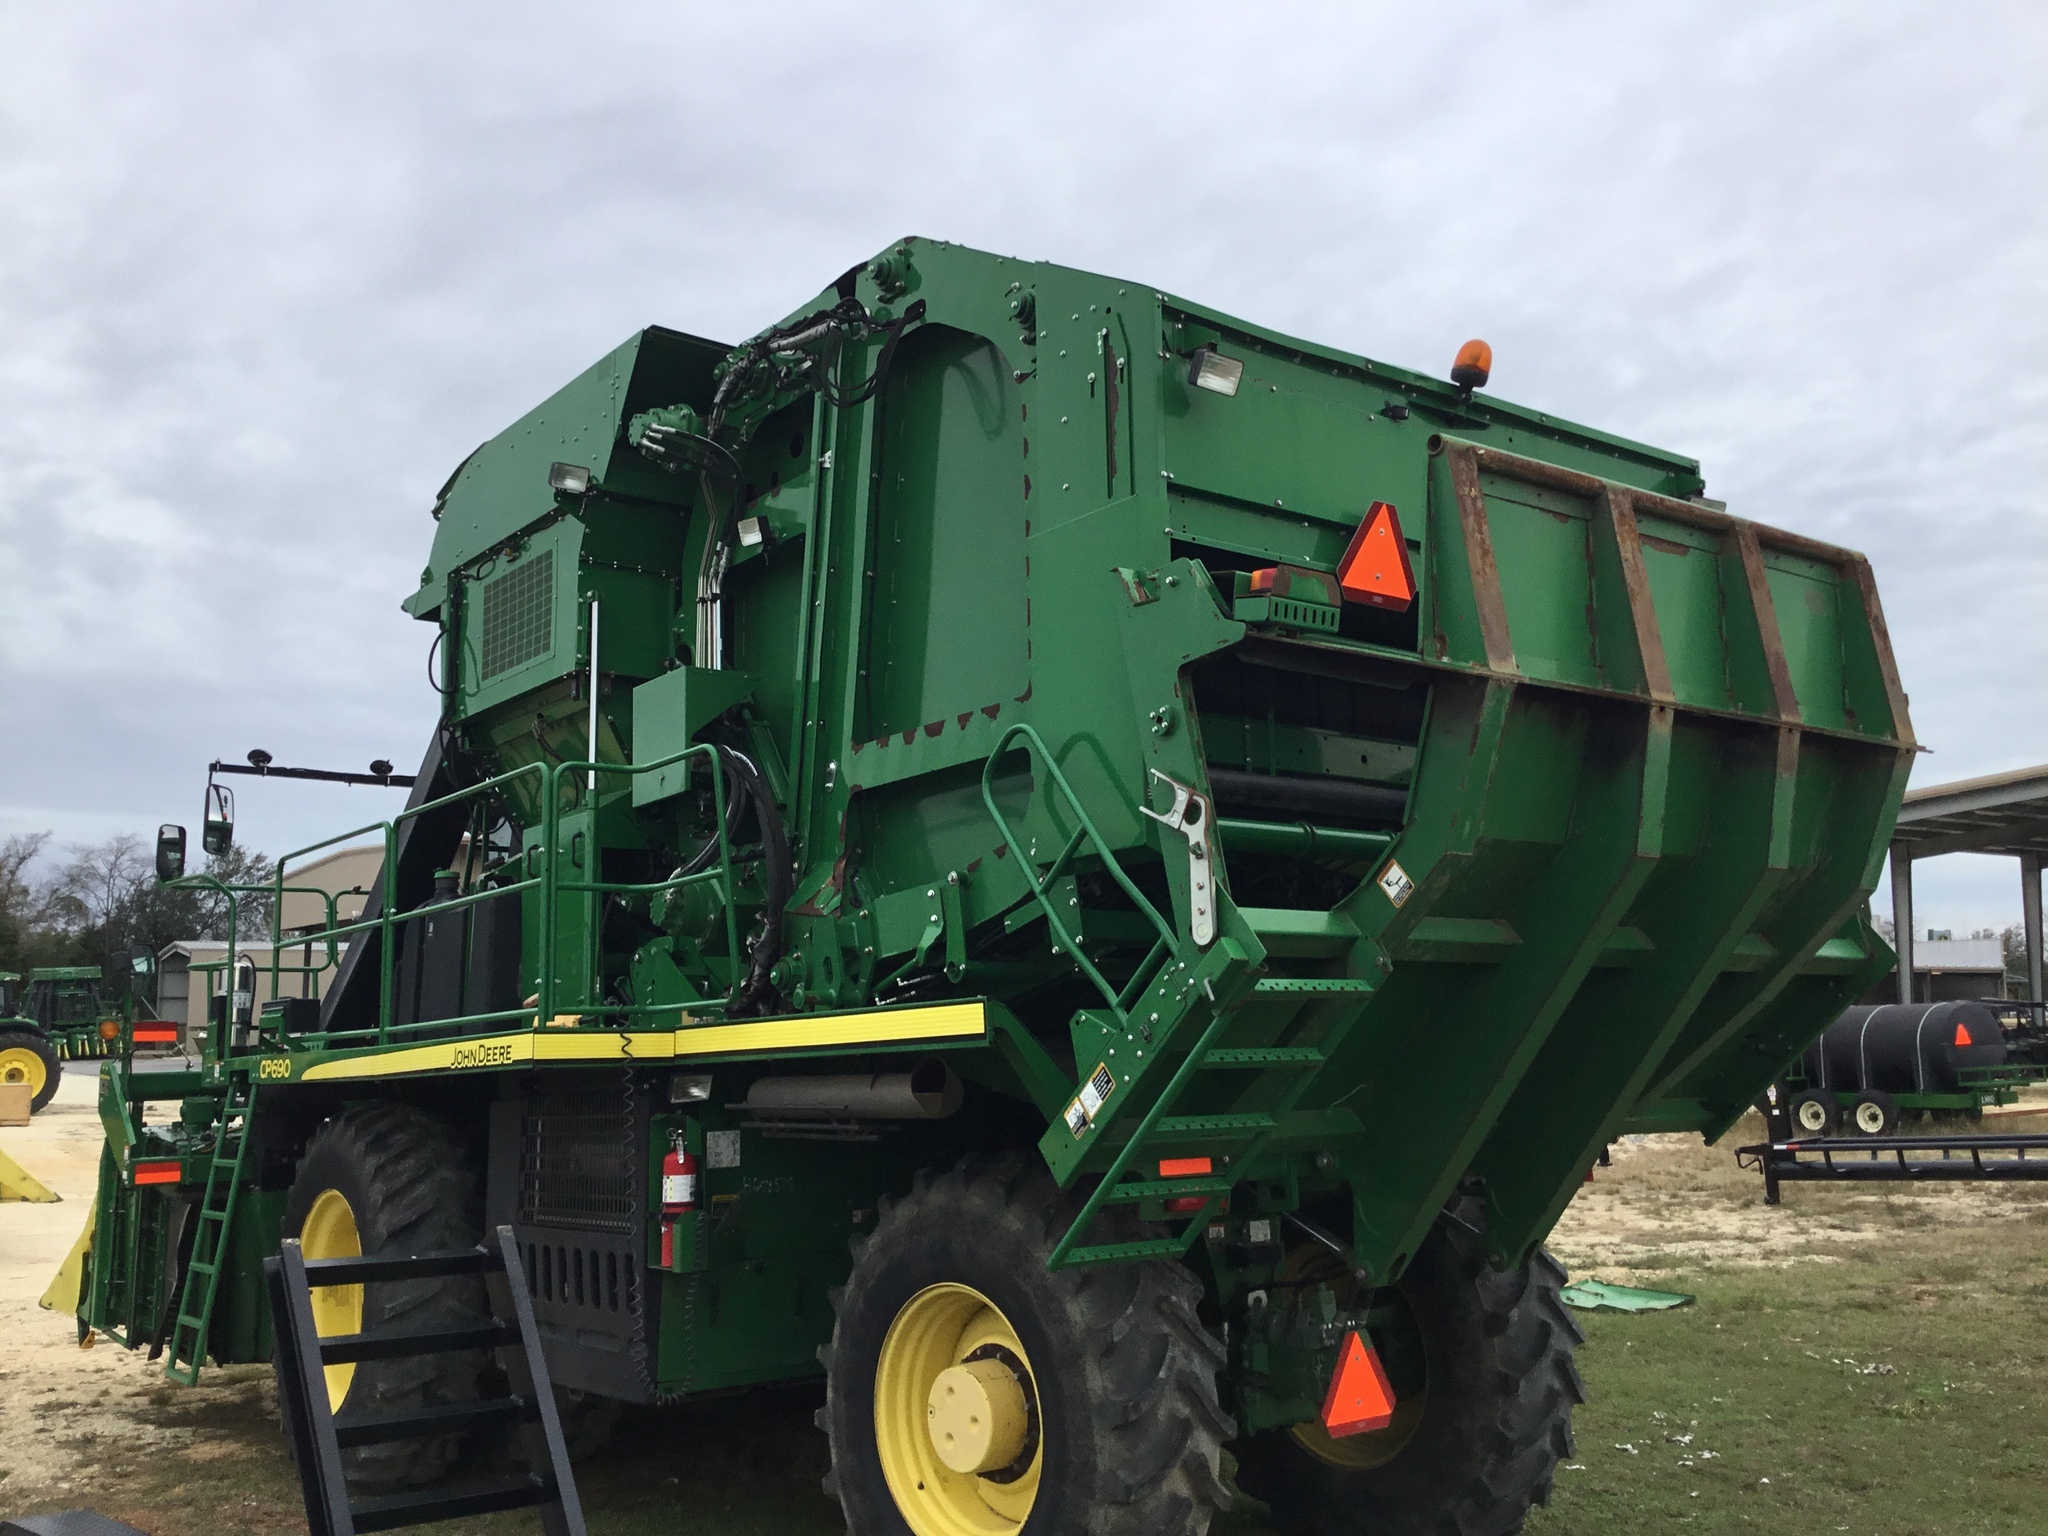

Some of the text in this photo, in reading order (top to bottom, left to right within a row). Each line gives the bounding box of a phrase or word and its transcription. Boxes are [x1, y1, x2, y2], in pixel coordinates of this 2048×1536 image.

[451, 1044, 512, 1067] JOHN DEERE
[259, 1059, 291, 1079] CP690
